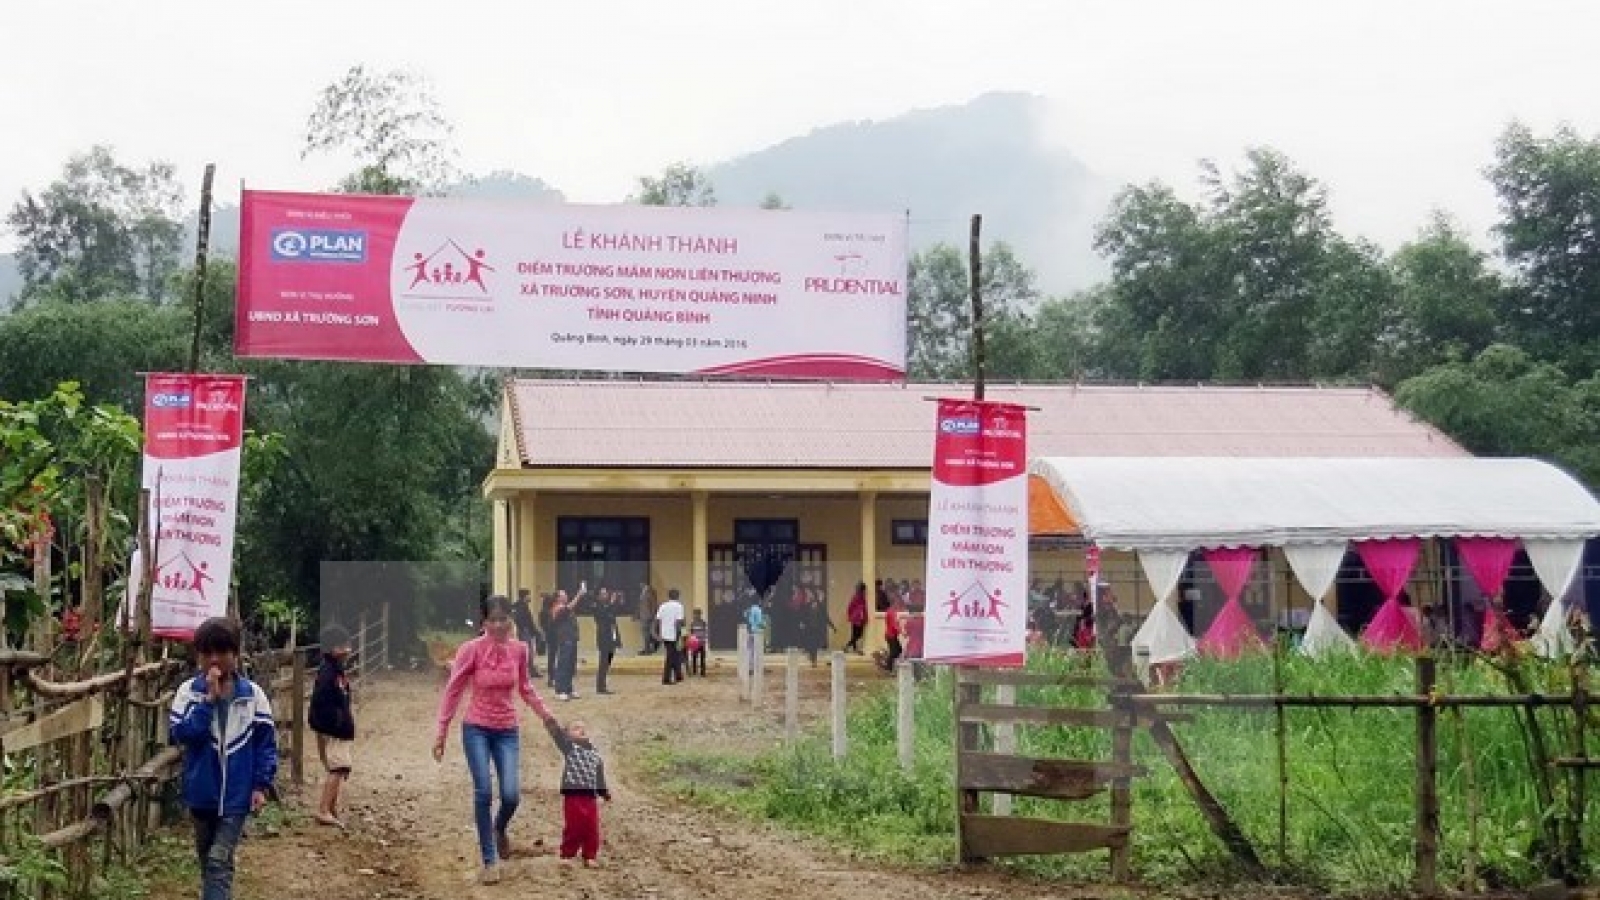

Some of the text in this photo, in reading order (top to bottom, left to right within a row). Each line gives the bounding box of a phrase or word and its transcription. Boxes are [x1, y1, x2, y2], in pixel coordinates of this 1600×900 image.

[309, 235, 362, 252] PLAN
[562, 226, 738, 254] LỄ KHÁNH THÀNH
[518, 260, 781, 285] ĐIỂM TRƯỜNG MẦM NON LIÊN THƯỢNG
[520, 282, 776, 305] XÃ TRƯỜNG SƠN, HUYỆN QUẢNG NINH
[804, 276, 902, 295] PRUDENTIAL
[248, 309, 379, 327] UBND XÃ TRƯỜNG SƠN
[587, 305, 710, 325] TỈNH QUẢNG BÌNH
[550, 332, 584, 345] Quảng
[613, 335, 638, 346] ngày
[654, 336, 684, 348] tháng
[700, 337, 722, 347] năm
[724, 337, 748, 349] 2016
